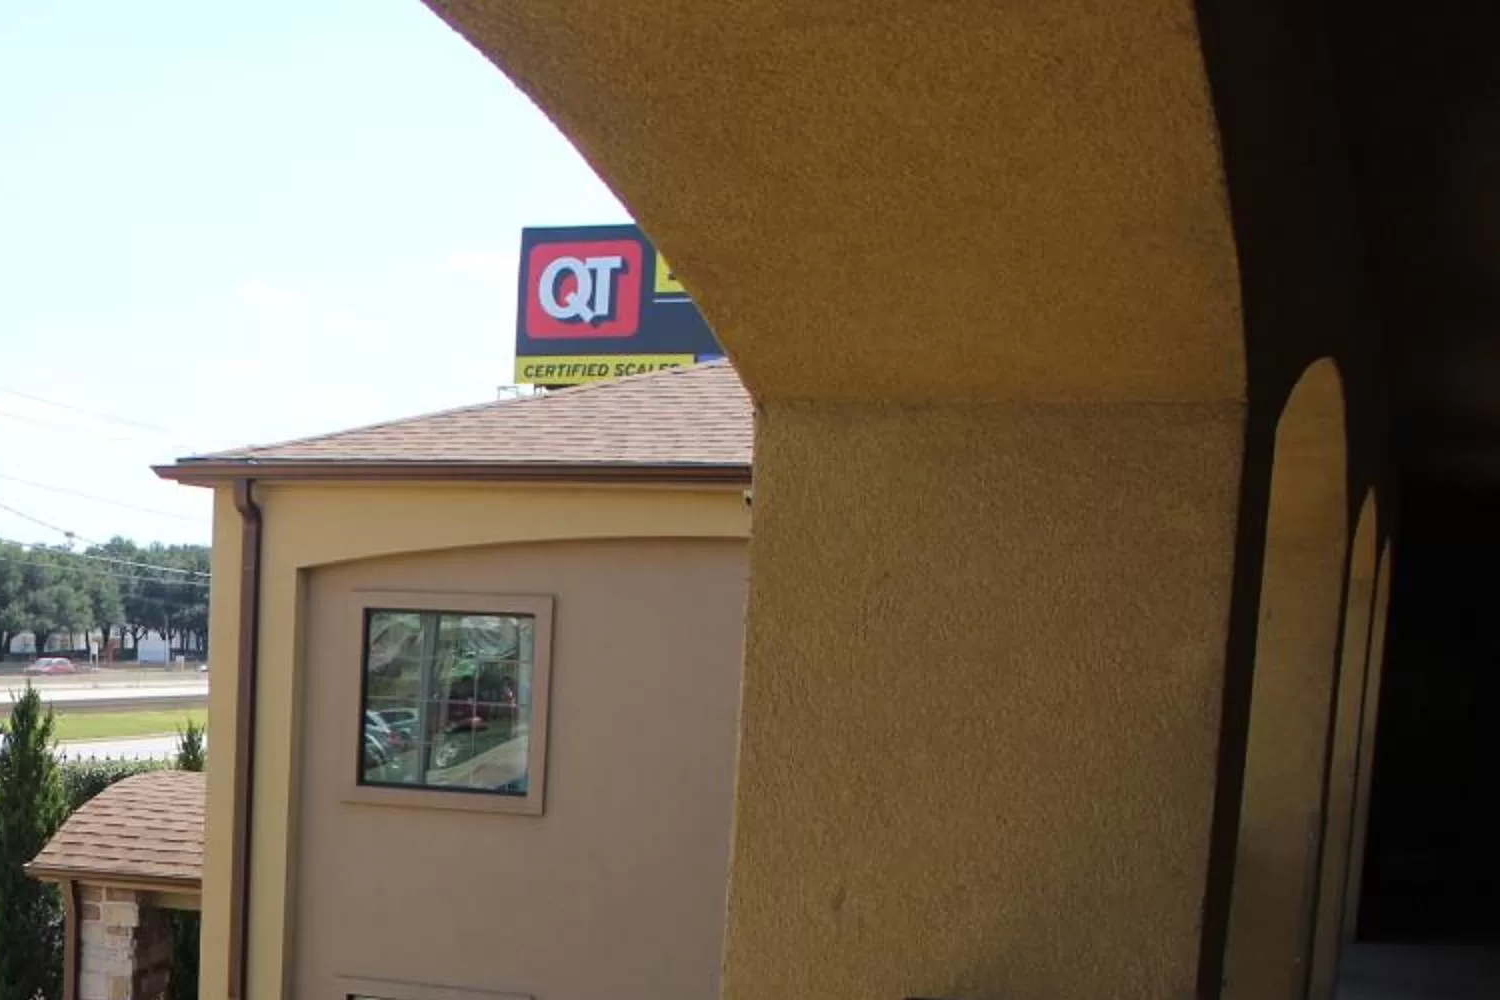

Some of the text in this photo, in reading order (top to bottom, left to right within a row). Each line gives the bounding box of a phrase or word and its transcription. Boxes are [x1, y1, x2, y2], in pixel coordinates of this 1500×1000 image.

[538, 256, 623, 323] QT
[523, 362, 681, 379] CERTIFIED SCA
